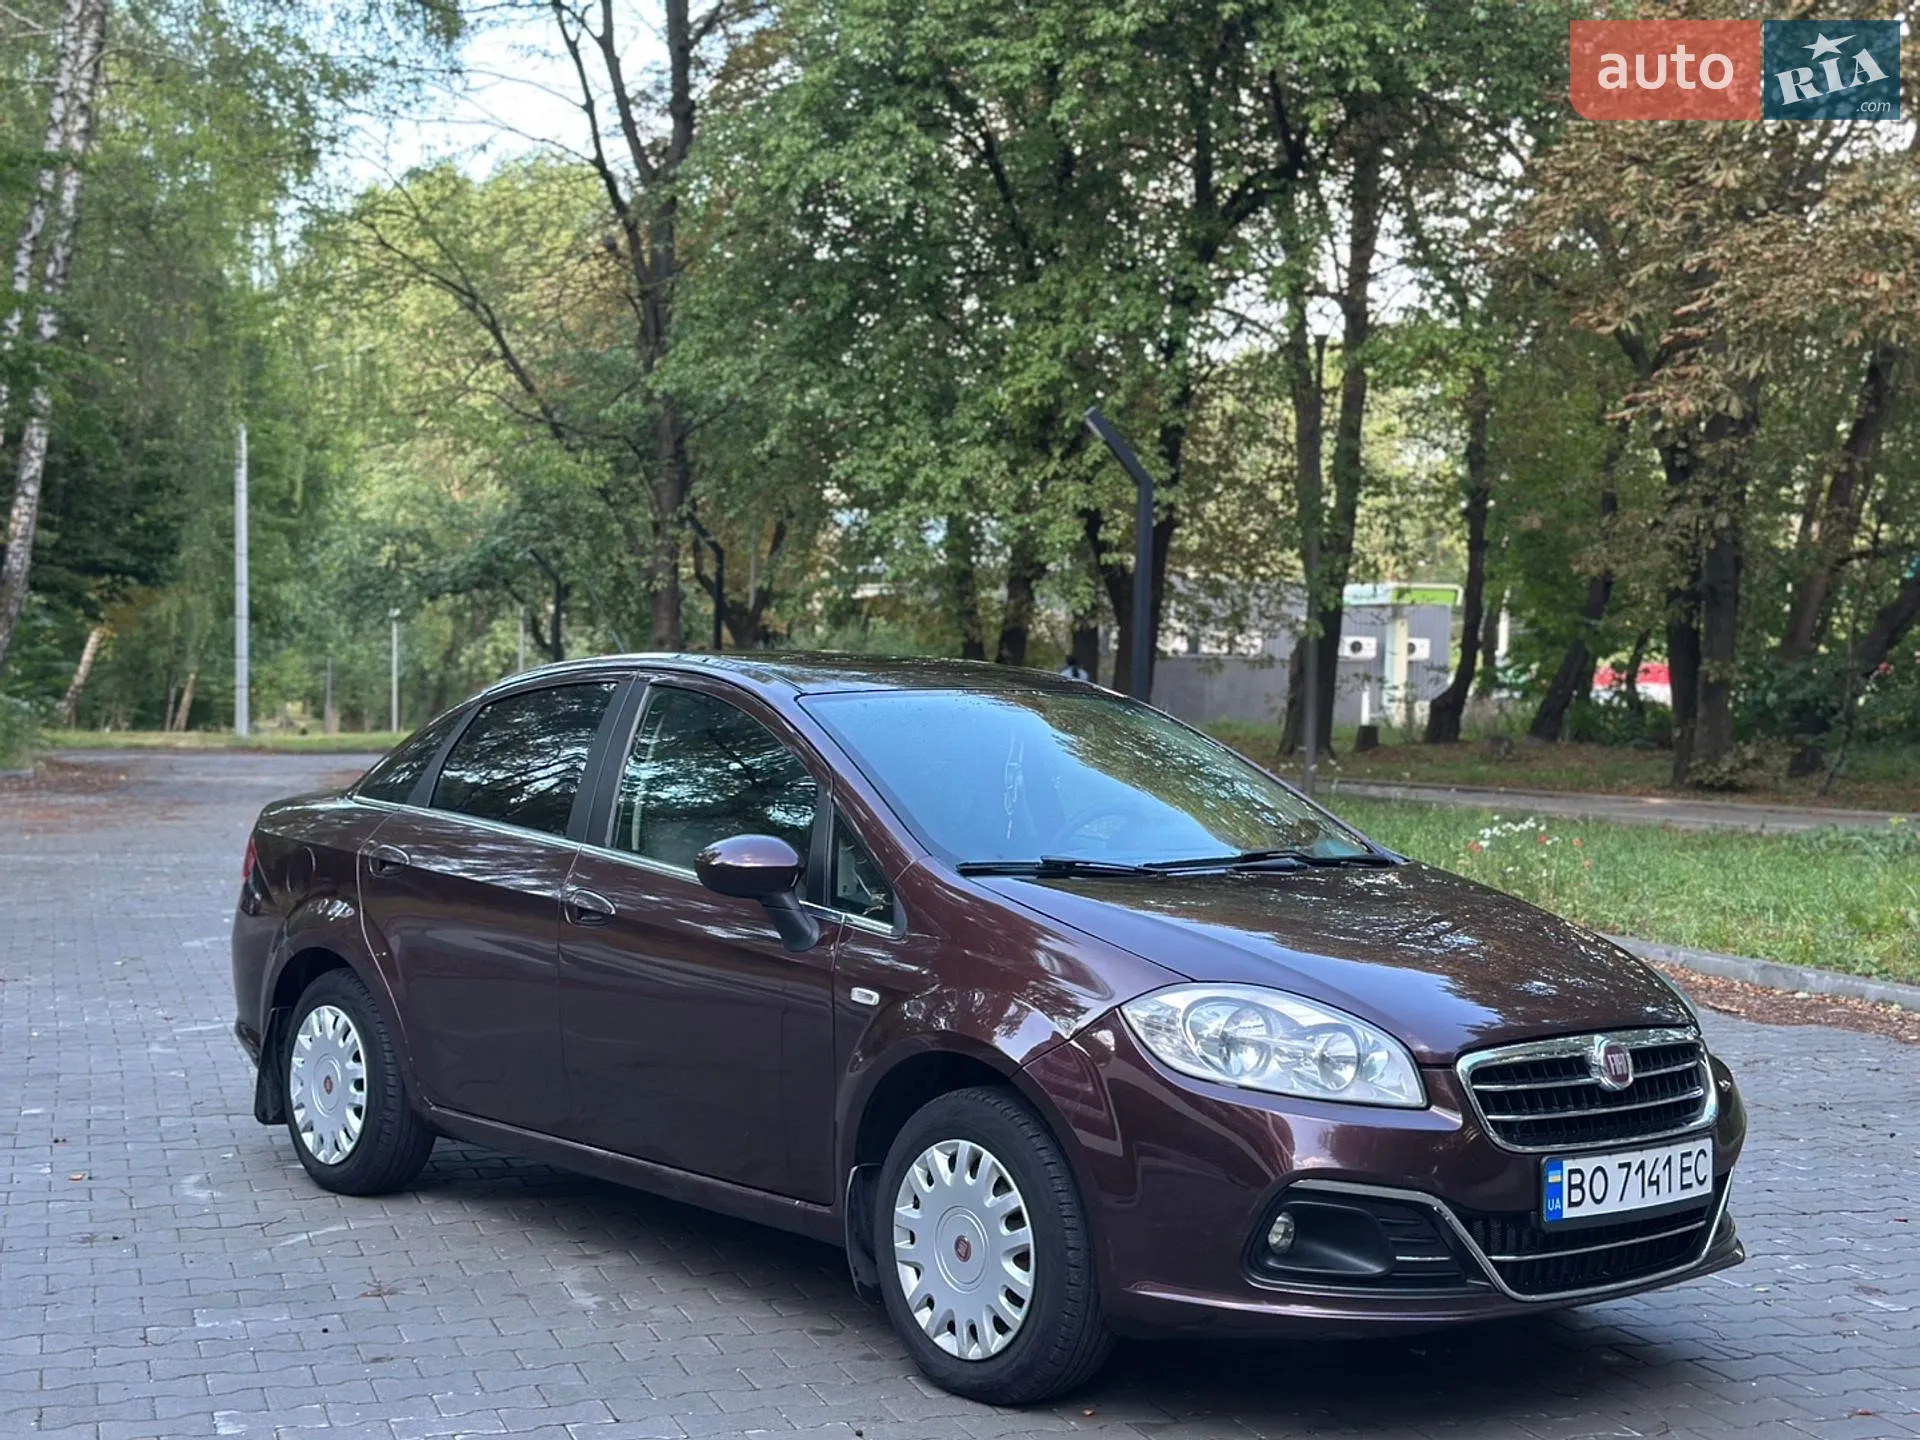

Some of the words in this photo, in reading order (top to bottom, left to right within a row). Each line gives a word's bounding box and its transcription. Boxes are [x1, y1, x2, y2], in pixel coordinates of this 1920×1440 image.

[1567, 1165, 1609, 1209] BO
[1617, 1154, 1673, 1202] 7141
[1679, 1148, 1708, 1191] EC
[1547, 1197, 1562, 1211] UA
